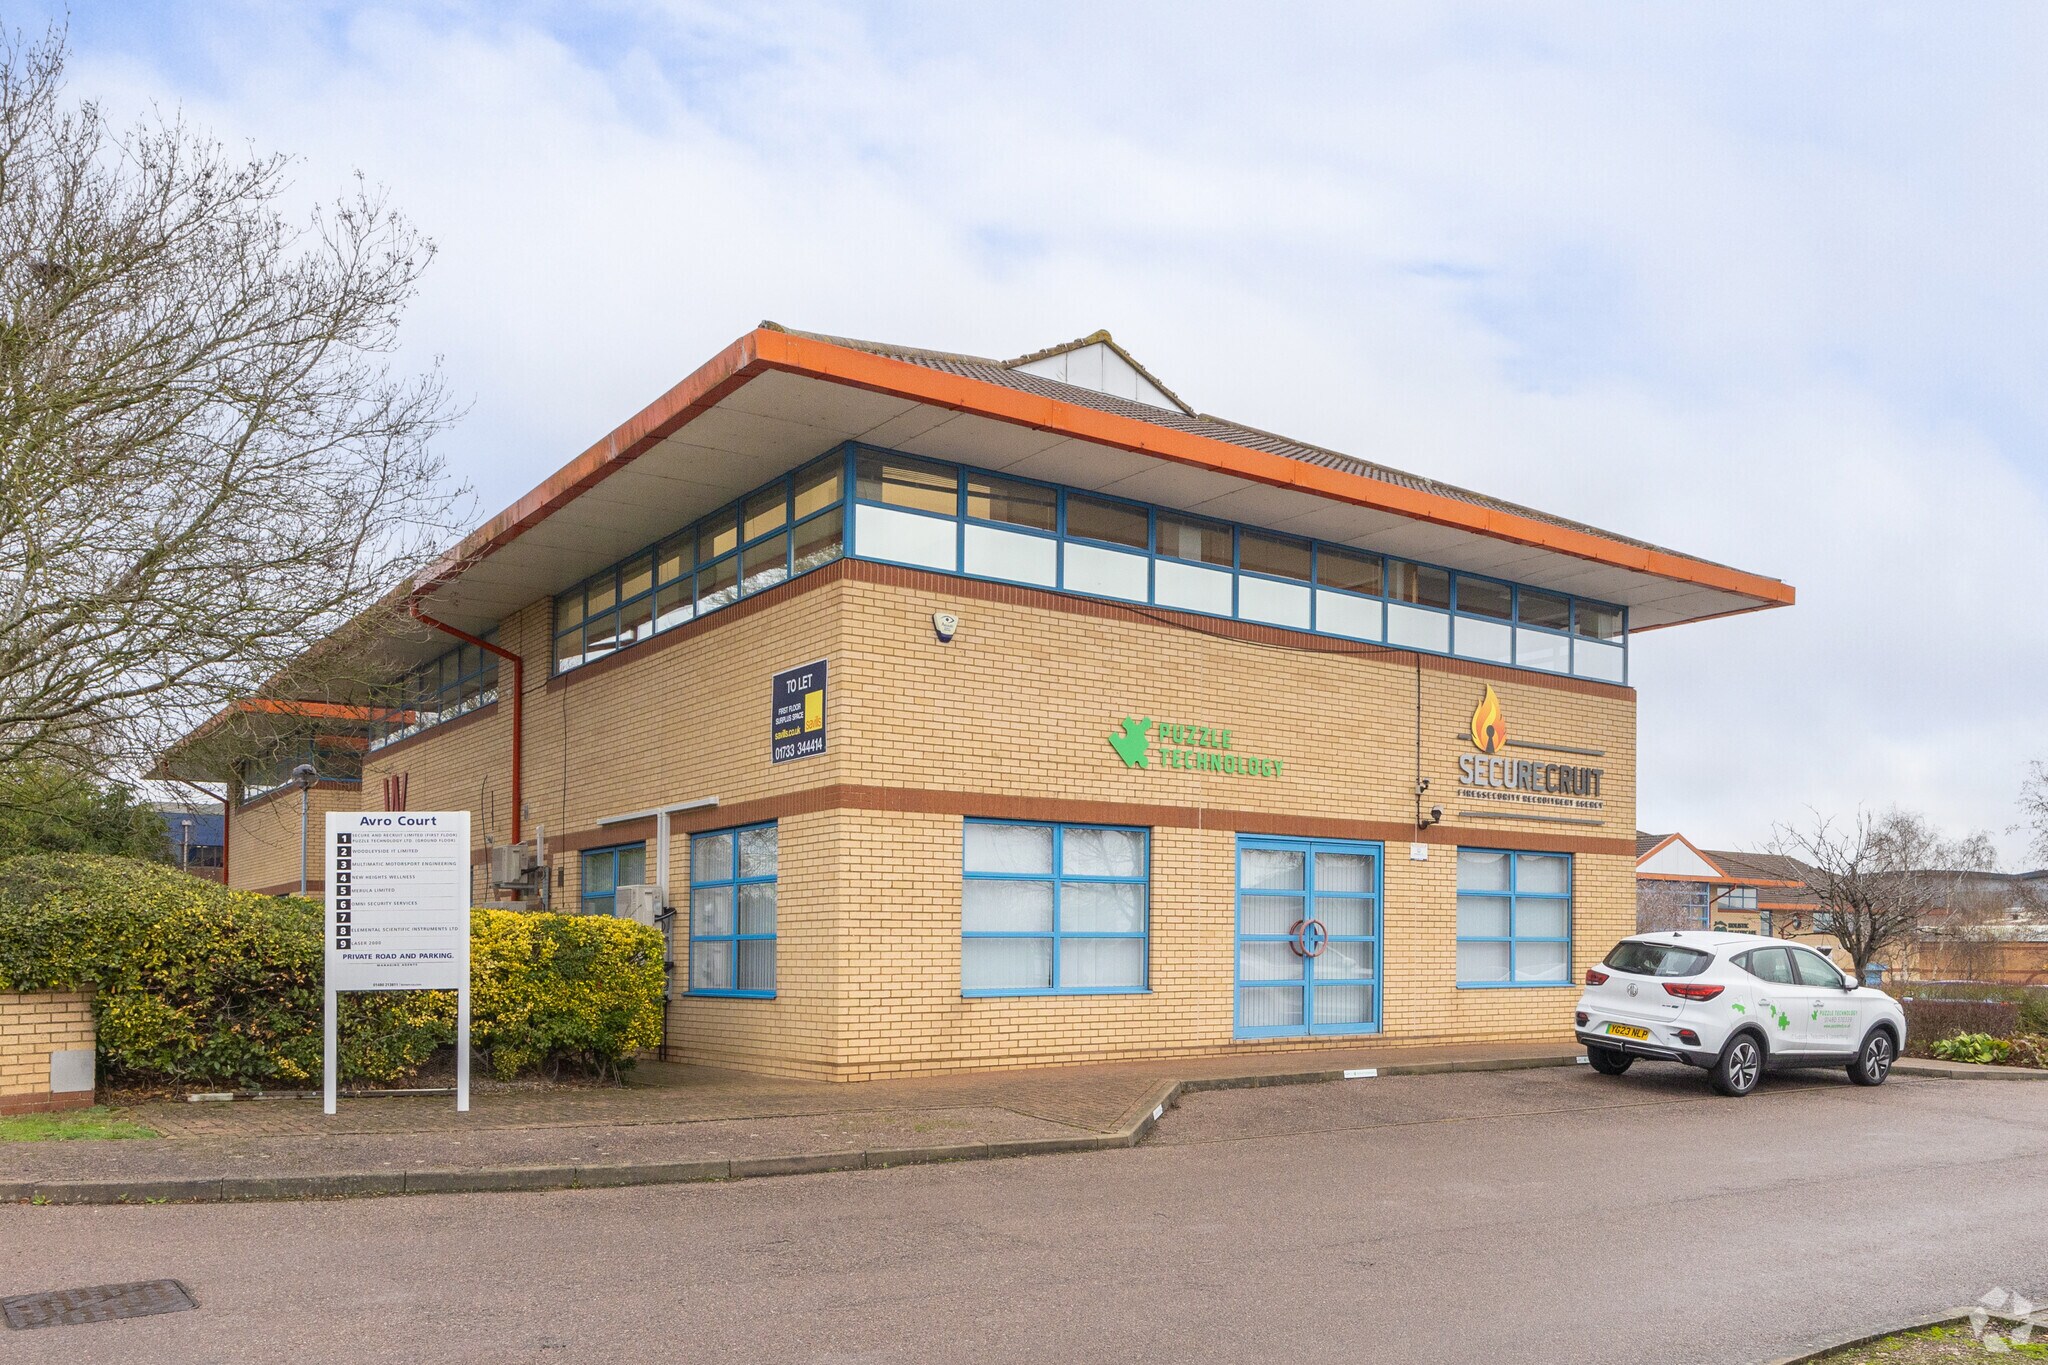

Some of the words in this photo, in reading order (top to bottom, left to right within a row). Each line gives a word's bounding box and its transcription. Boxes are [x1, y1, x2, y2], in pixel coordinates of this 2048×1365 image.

[786, 678, 797, 694] TO
[798, 673, 813, 690] LET
[778, 706, 788, 715] FIRST
[788, 702, 801, 712] FLOOR
[775, 715, 792, 725] SURPLUS
[792, 711, 804, 721] SPACE
[805, 715, 822, 730] savills
[774, 726, 801, 740] savills.co.uk
[1159, 722, 1232, 749] PUZZLE
[775, 743, 795, 760] 01733
[796, 737, 823, 756] 344414
[1158, 748, 1284, 777] TECHNOLOGY
[1458, 753, 1605, 797] SECURECRUIT
[1522, 794, 1573, 807] RECRUITMENT
[1575, 800, 1604, 810] AGENCY
[360, 816, 392, 826] Avro
[397, 815, 437, 826] Court
[340, 848, 347, 856] 2
[340, 861, 347, 869] 3
[340, 874, 347, 882] 4
[340, 887, 347, 895] 5
[340, 901, 347, 909] 6
[340, 914, 347, 922] 7
[340, 927, 347, 935] 8
[340, 940, 347, 948] 9
[1611, 1024, 1630, 1036] YG23
[1631, 1027, 1649, 1039] NLP
